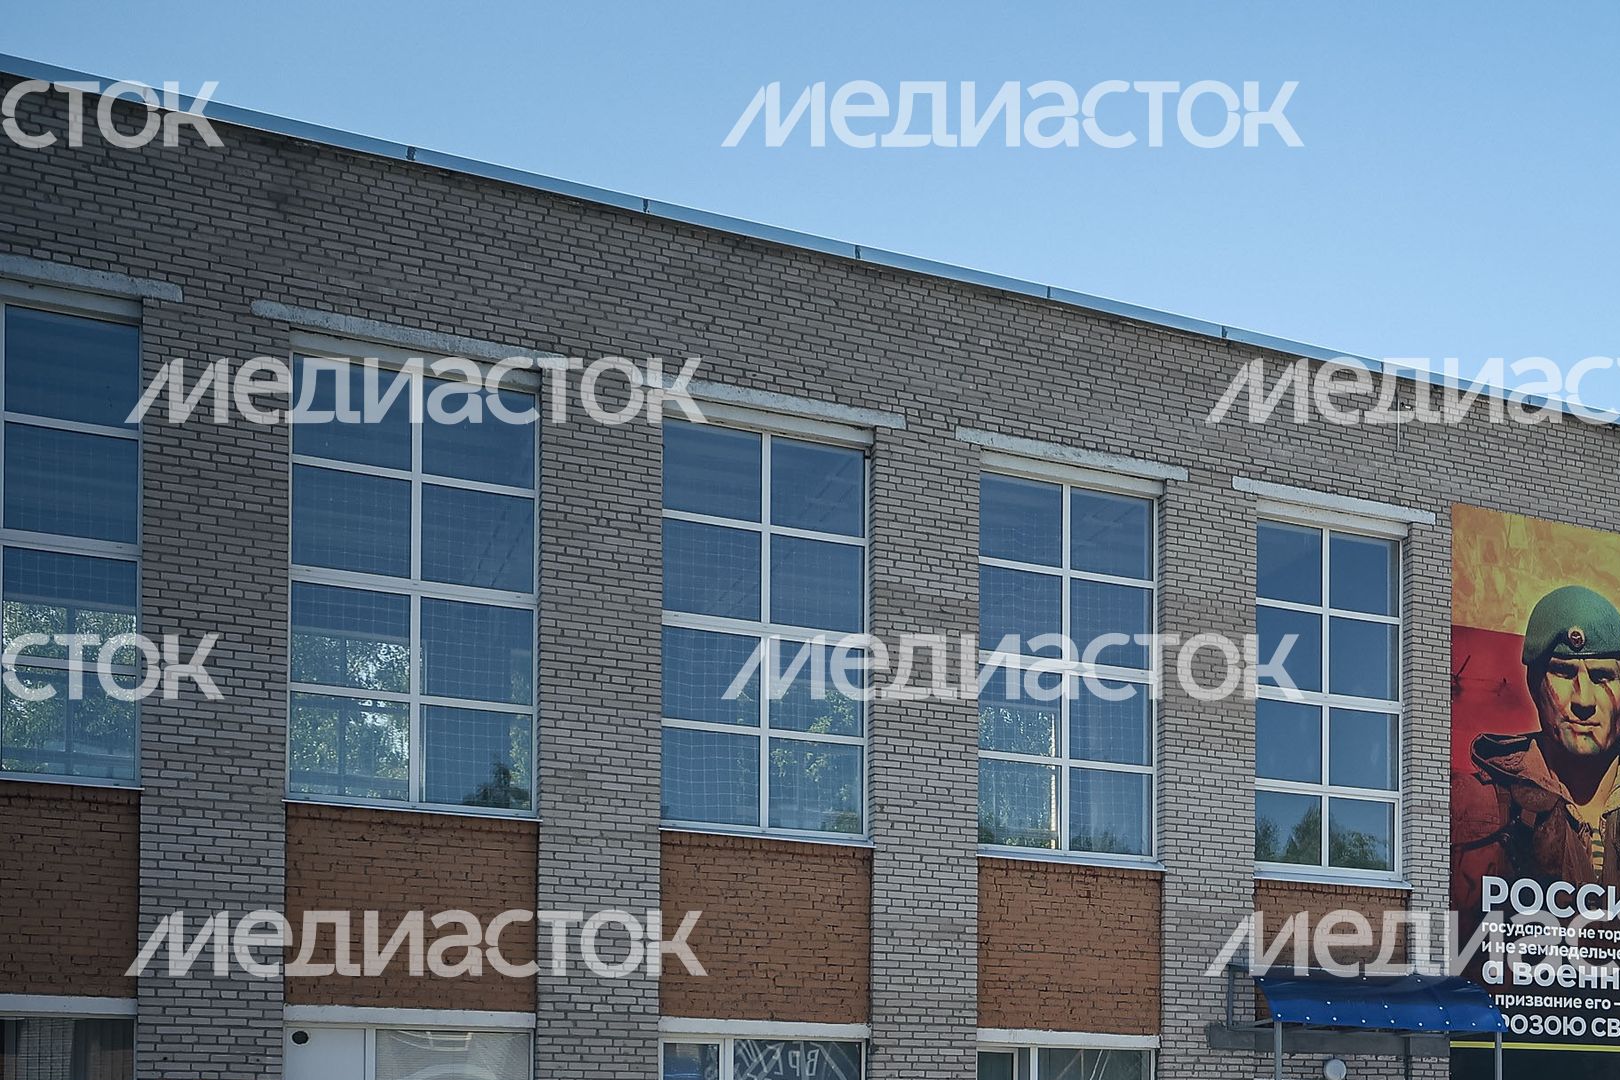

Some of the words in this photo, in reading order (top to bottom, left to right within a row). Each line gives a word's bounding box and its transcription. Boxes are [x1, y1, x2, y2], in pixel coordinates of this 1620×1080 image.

[1482, 922, 1576, 938] государство
[1579, 928, 1596, 939] не
[1495, 941, 1516, 954] не
[1482, 960, 1504, 985] а
[1495, 994, 1583, 1009] призвание
[1585, 998, 1611, 1010] его
[1501, 1013, 1587, 1037] ОЗОЮ
